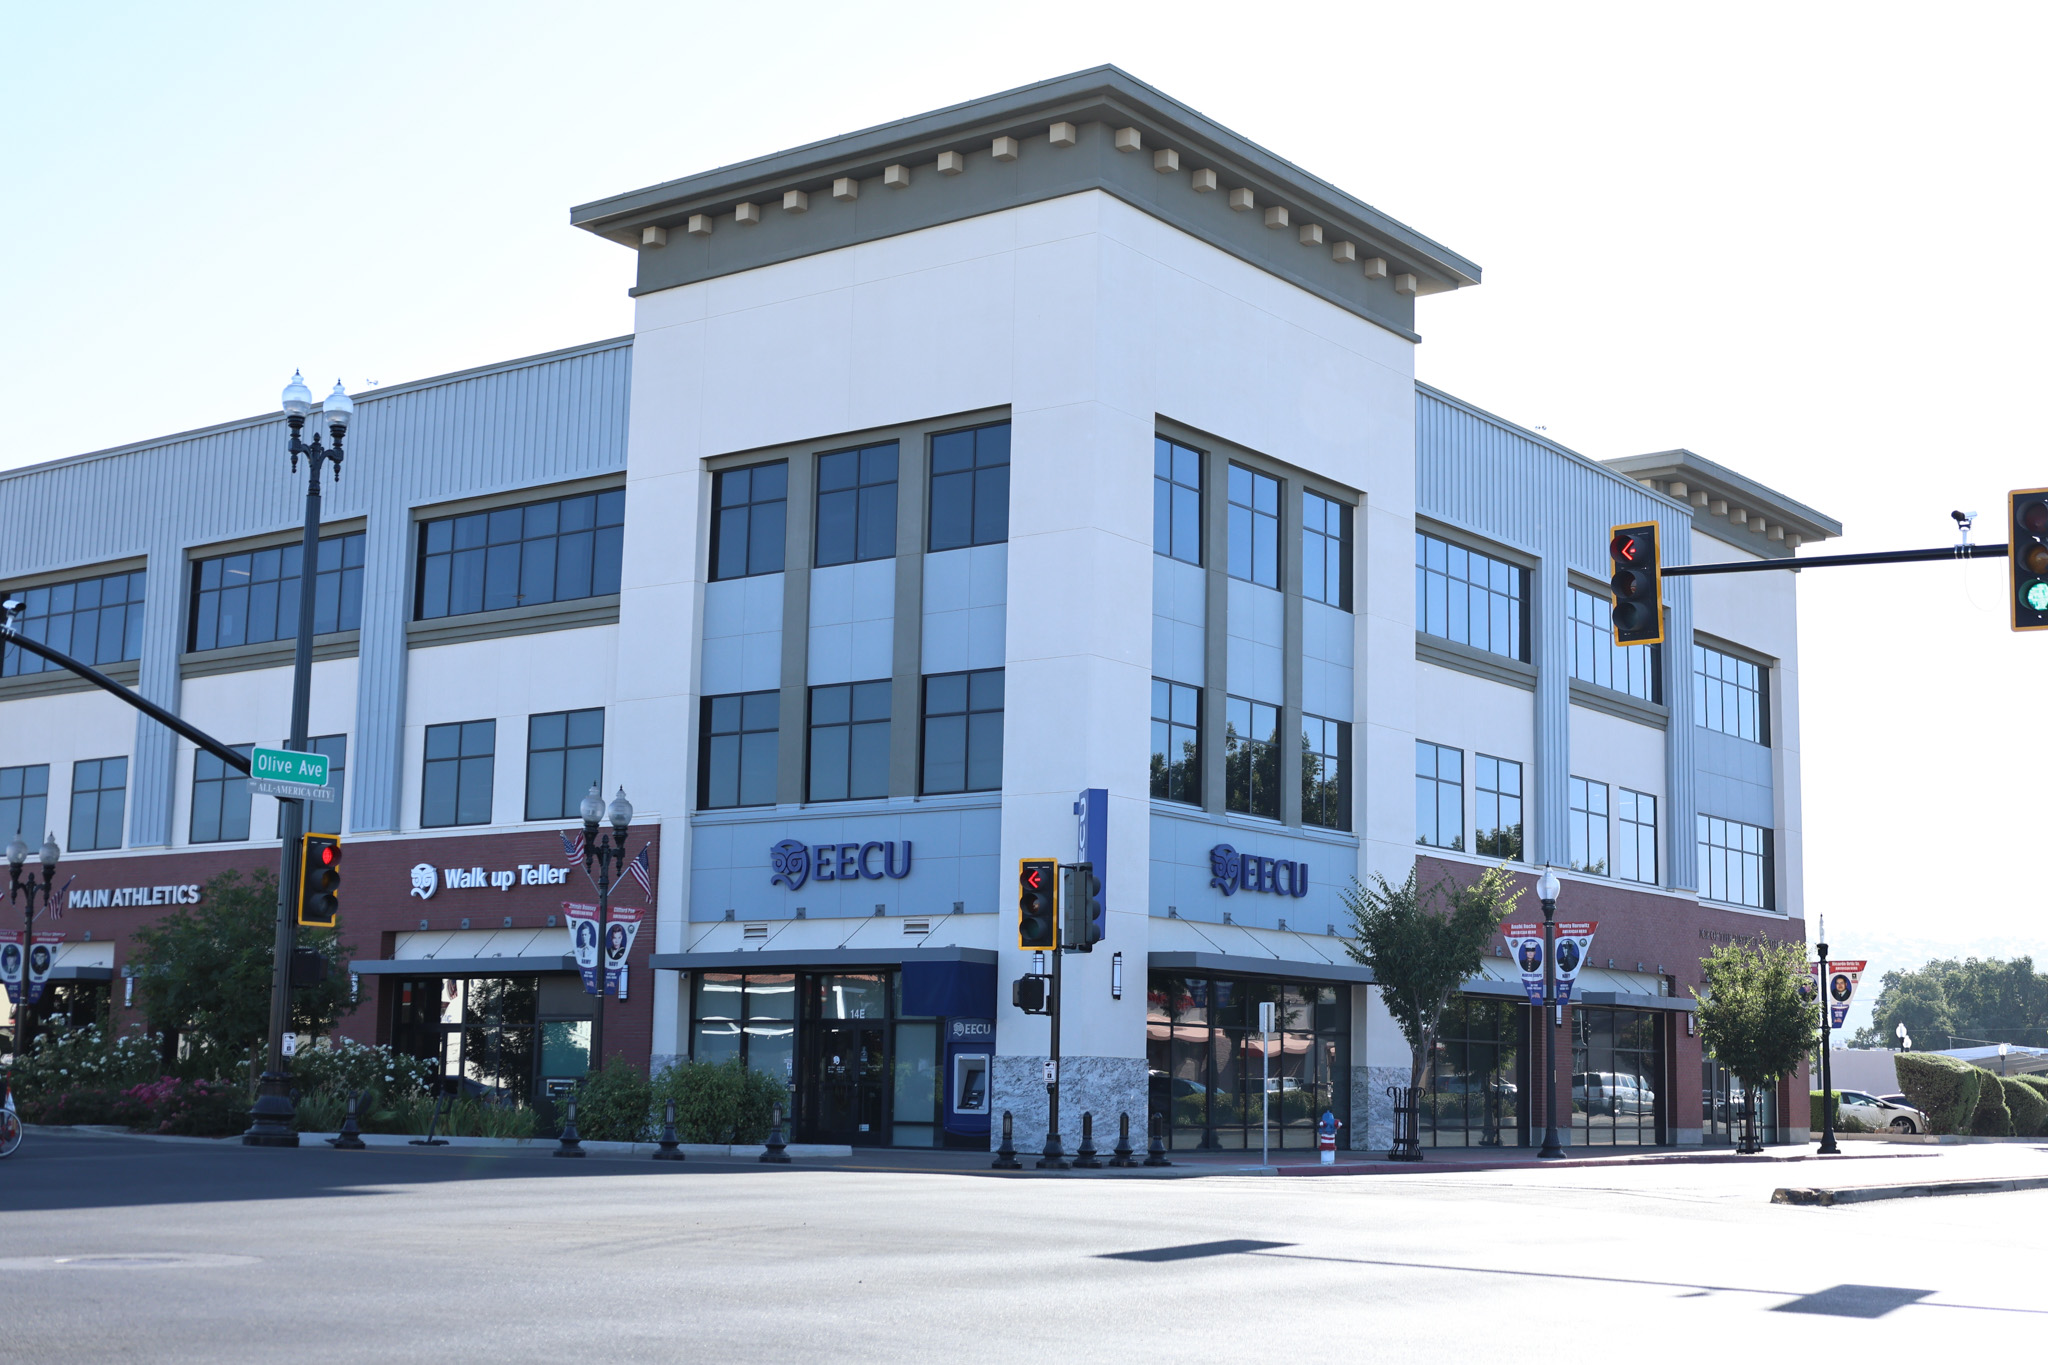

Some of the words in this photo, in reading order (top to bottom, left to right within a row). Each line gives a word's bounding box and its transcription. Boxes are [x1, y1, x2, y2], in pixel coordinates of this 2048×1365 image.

[258, 754, 292, 774] Olive
[298, 760, 322, 777] Ave
[257, 783, 311, 798] ALL-AMERICA
[312, 789, 332, 799] CITY
[1079, 797, 1087, 863] ECU
[812, 840, 912, 881] EECU
[444, 867, 488, 889] Walk
[490, 870, 516, 891] up
[517, 864, 570, 885] Teller
[1240, 853, 1309, 898] EECU
[68, 888, 110, 909] MAIN
[111, 884, 200, 907] ATHLETICS
[850, 1008, 865, 1019] 14E
[964, 1023, 991, 1035] EECU
